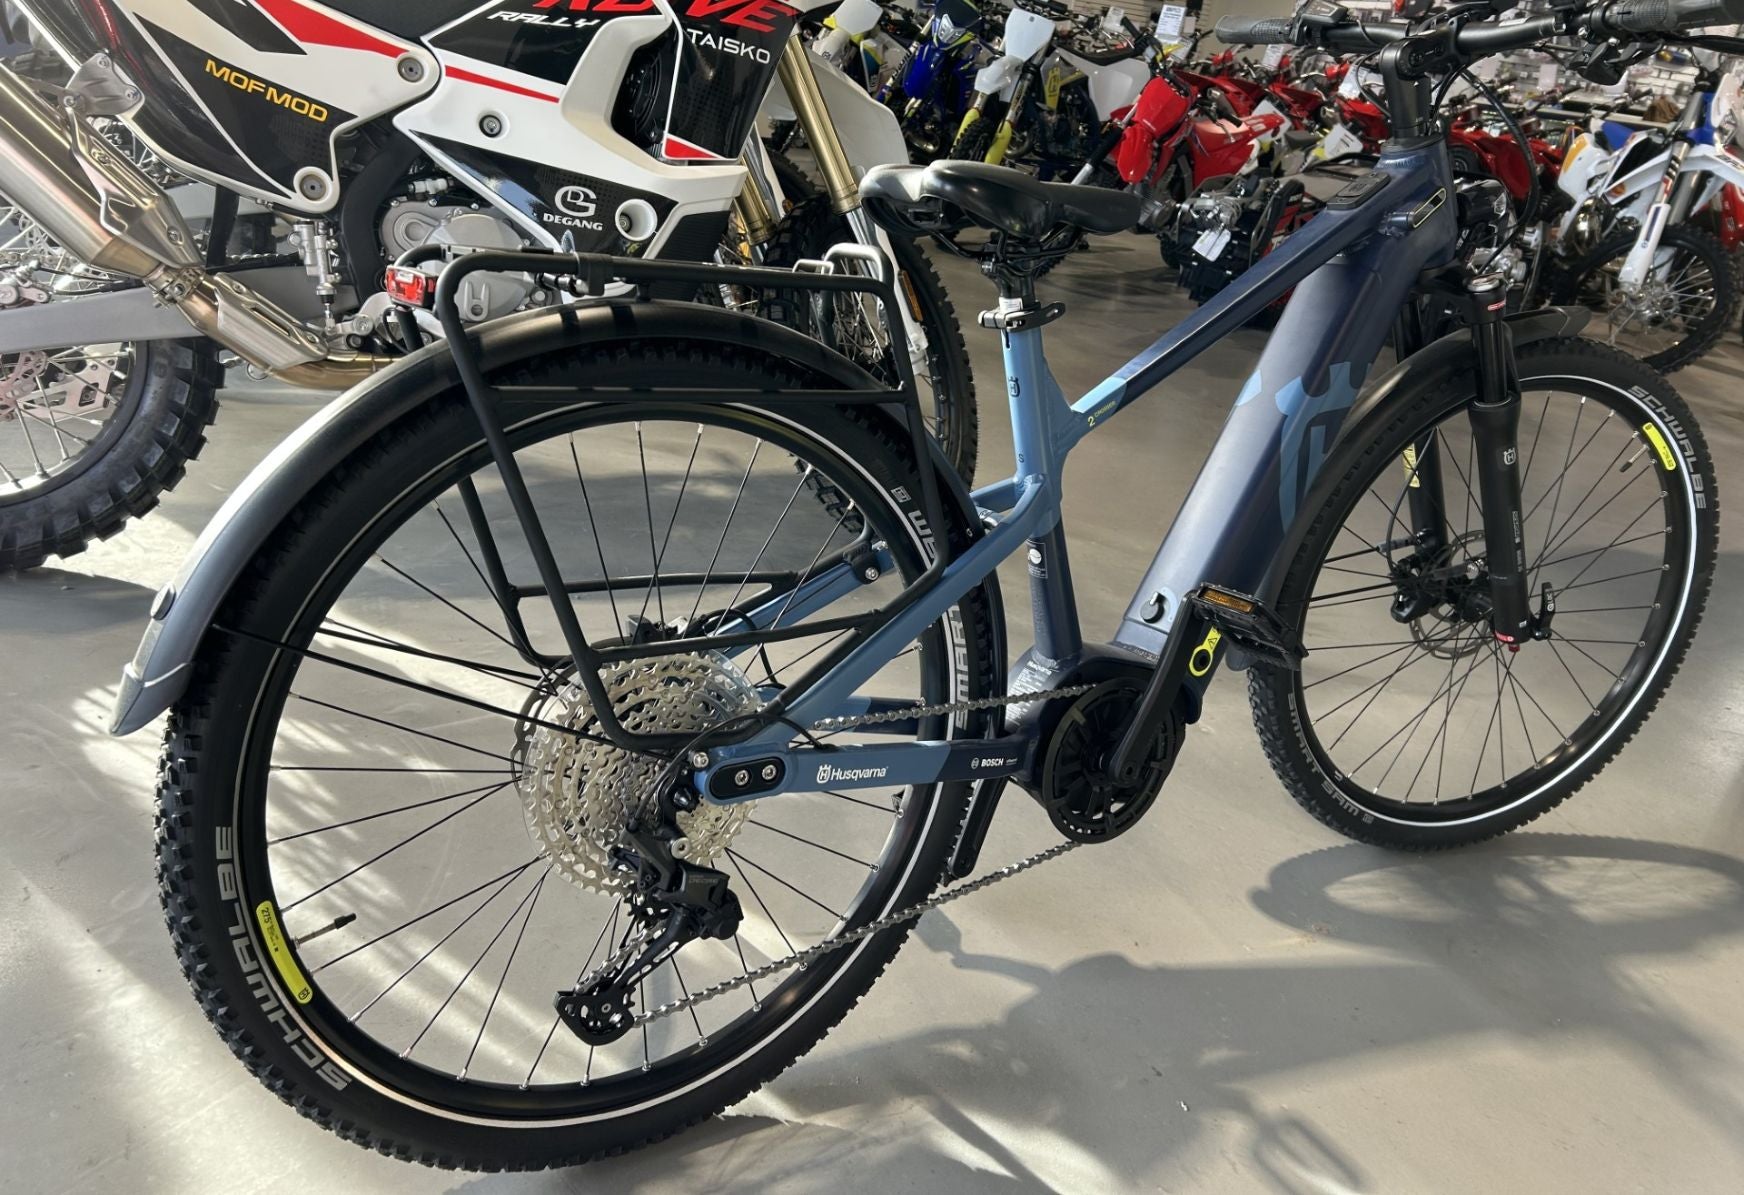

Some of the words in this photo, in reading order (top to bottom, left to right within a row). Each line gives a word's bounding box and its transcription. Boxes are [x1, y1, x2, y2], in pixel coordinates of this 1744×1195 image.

[487, 11, 601, 28] RALLY
[686, 28, 770, 65] TAISKO
[543, 212, 604, 231] DEGANG
[1627, 385, 1707, 509] SCHWALBE
[981, 758, 1005, 768] BOSCH
[1287, 692, 1320, 774] SMART
[1321, 780, 1360, 816] SAM
[830, 766, 887, 782] Husqvarna
[215, 825, 353, 1092] SCHWALBE
